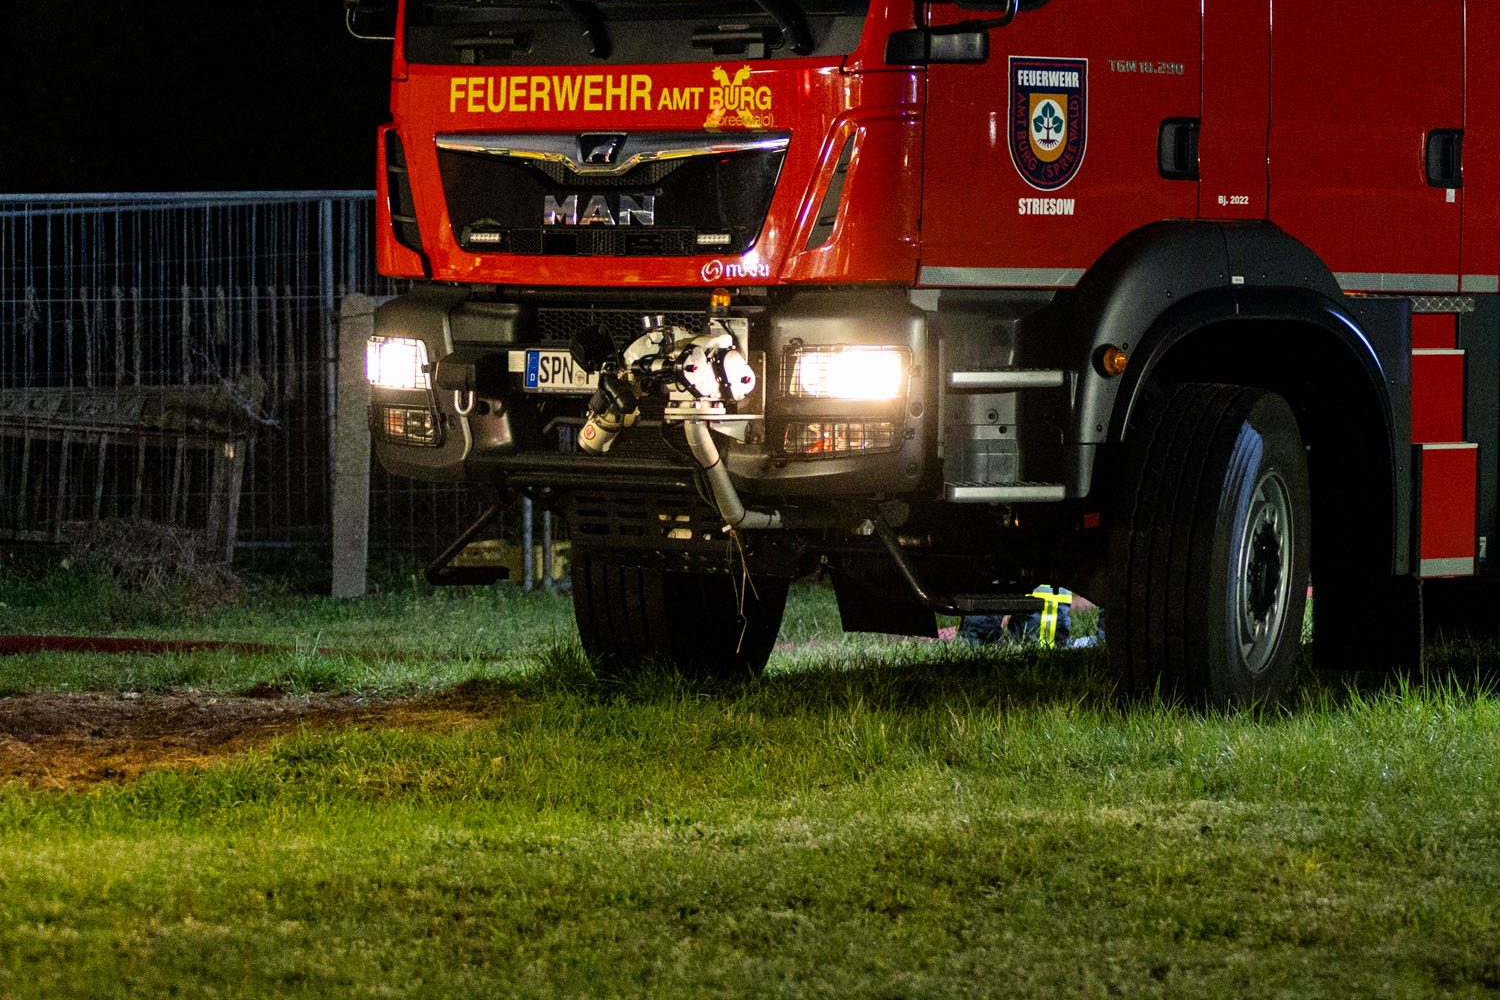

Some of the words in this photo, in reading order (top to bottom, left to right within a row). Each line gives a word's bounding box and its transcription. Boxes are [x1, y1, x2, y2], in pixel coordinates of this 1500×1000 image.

[1109, 59, 1137, 73] TGM
[1017, 69, 1080, 88] FEUERWEHR
[449, 74, 653, 113] FEUERWEHR
[657, 86, 705, 111] AMT
[709, 86, 772, 111] BURG
[1015, 91, 1028, 128] AMT
[1016, 131, 1039, 172] BURG
[543, 194, 655, 225] MAN
[1018, 197, 1075, 216] STRIESOW
[1218, 195, 1229, 207] Bj.
[1230, 195, 1249, 205] 2022
[530, 372, 536, 382] D
[539, 355, 574, 385] SPN
